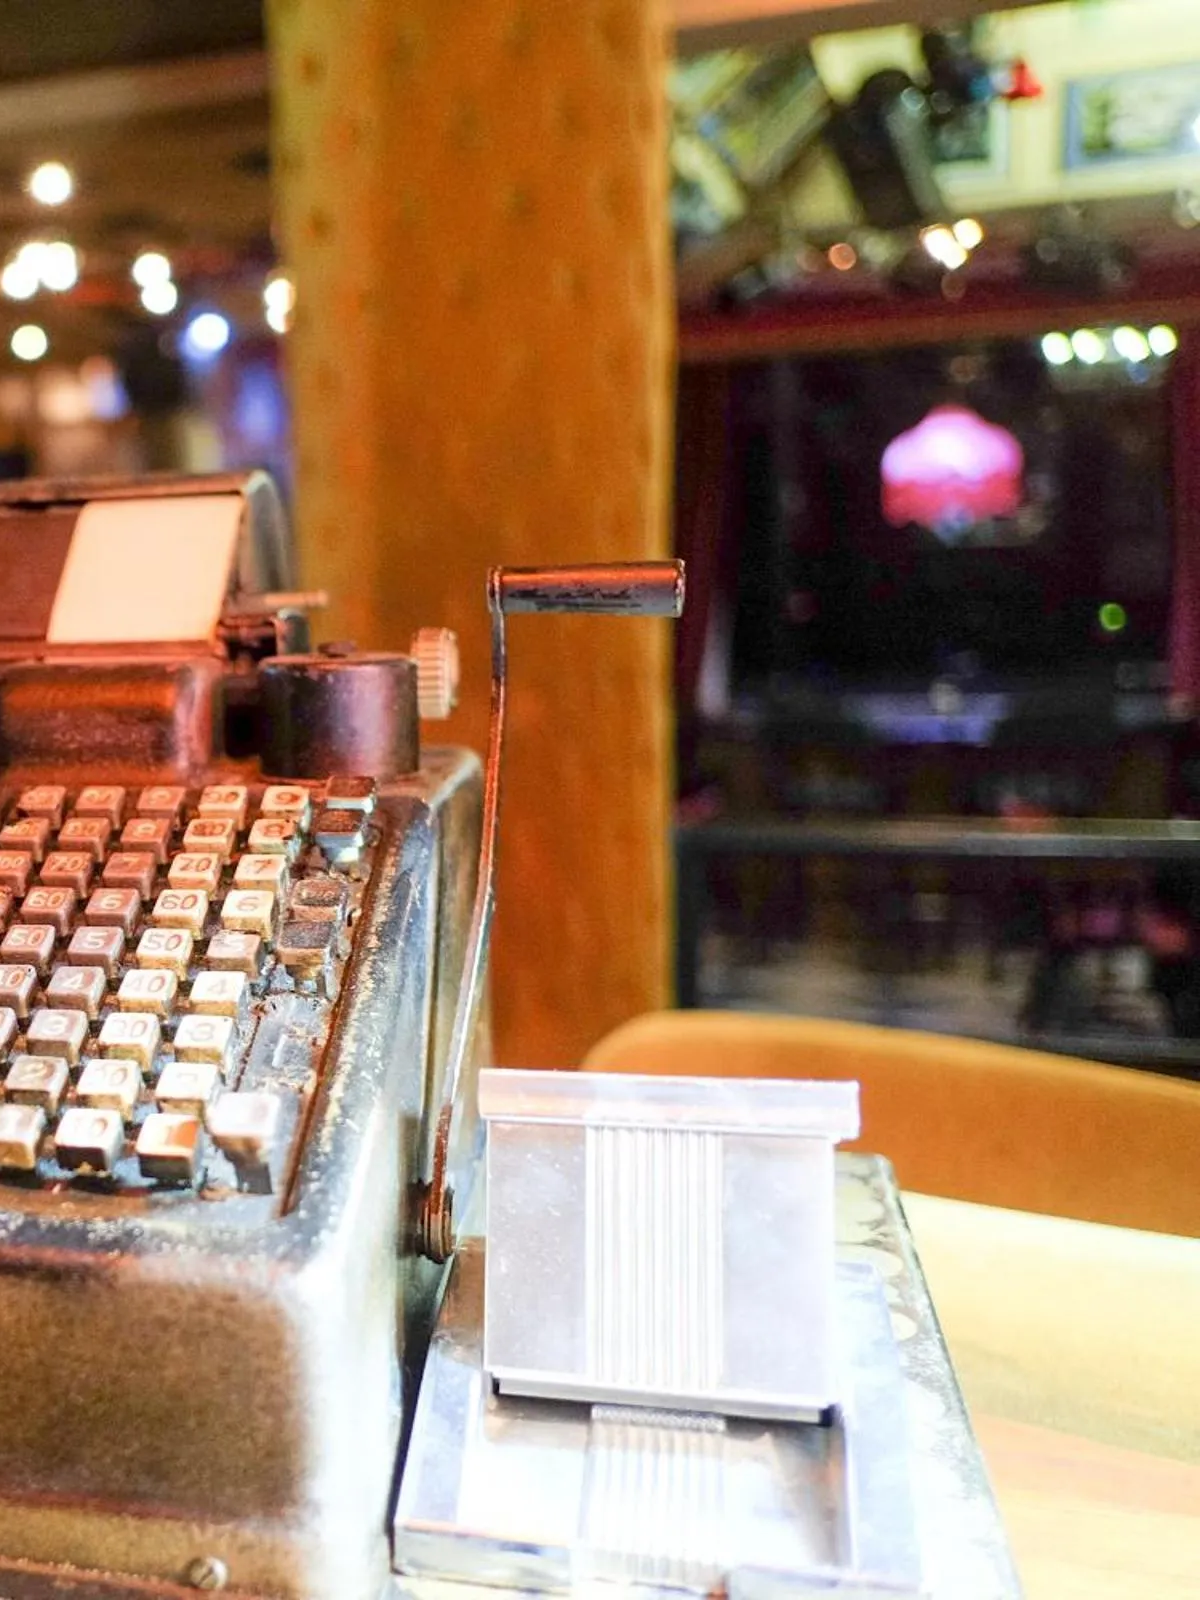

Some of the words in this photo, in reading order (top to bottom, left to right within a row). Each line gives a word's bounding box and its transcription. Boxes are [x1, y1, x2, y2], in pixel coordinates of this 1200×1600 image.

[49, 857, 86, 871] 70
[179, 856, 213, 873] 70
[253, 858, 274, 875] 7
[28, 891, 65, 907] 60
[100, 894, 125, 910] 6
[160, 894, 199, 911] 60
[235, 896, 260, 913] 6
[7, 929, 45, 946] 50
[83, 931, 109, 950] 5
[143, 933, 182, 952] 50
[62, 972, 86, 990] 4
[125, 974, 166, 993] 40
[40, 1015, 69, 1035] 3
[186, 1022, 216, 1042] 3
